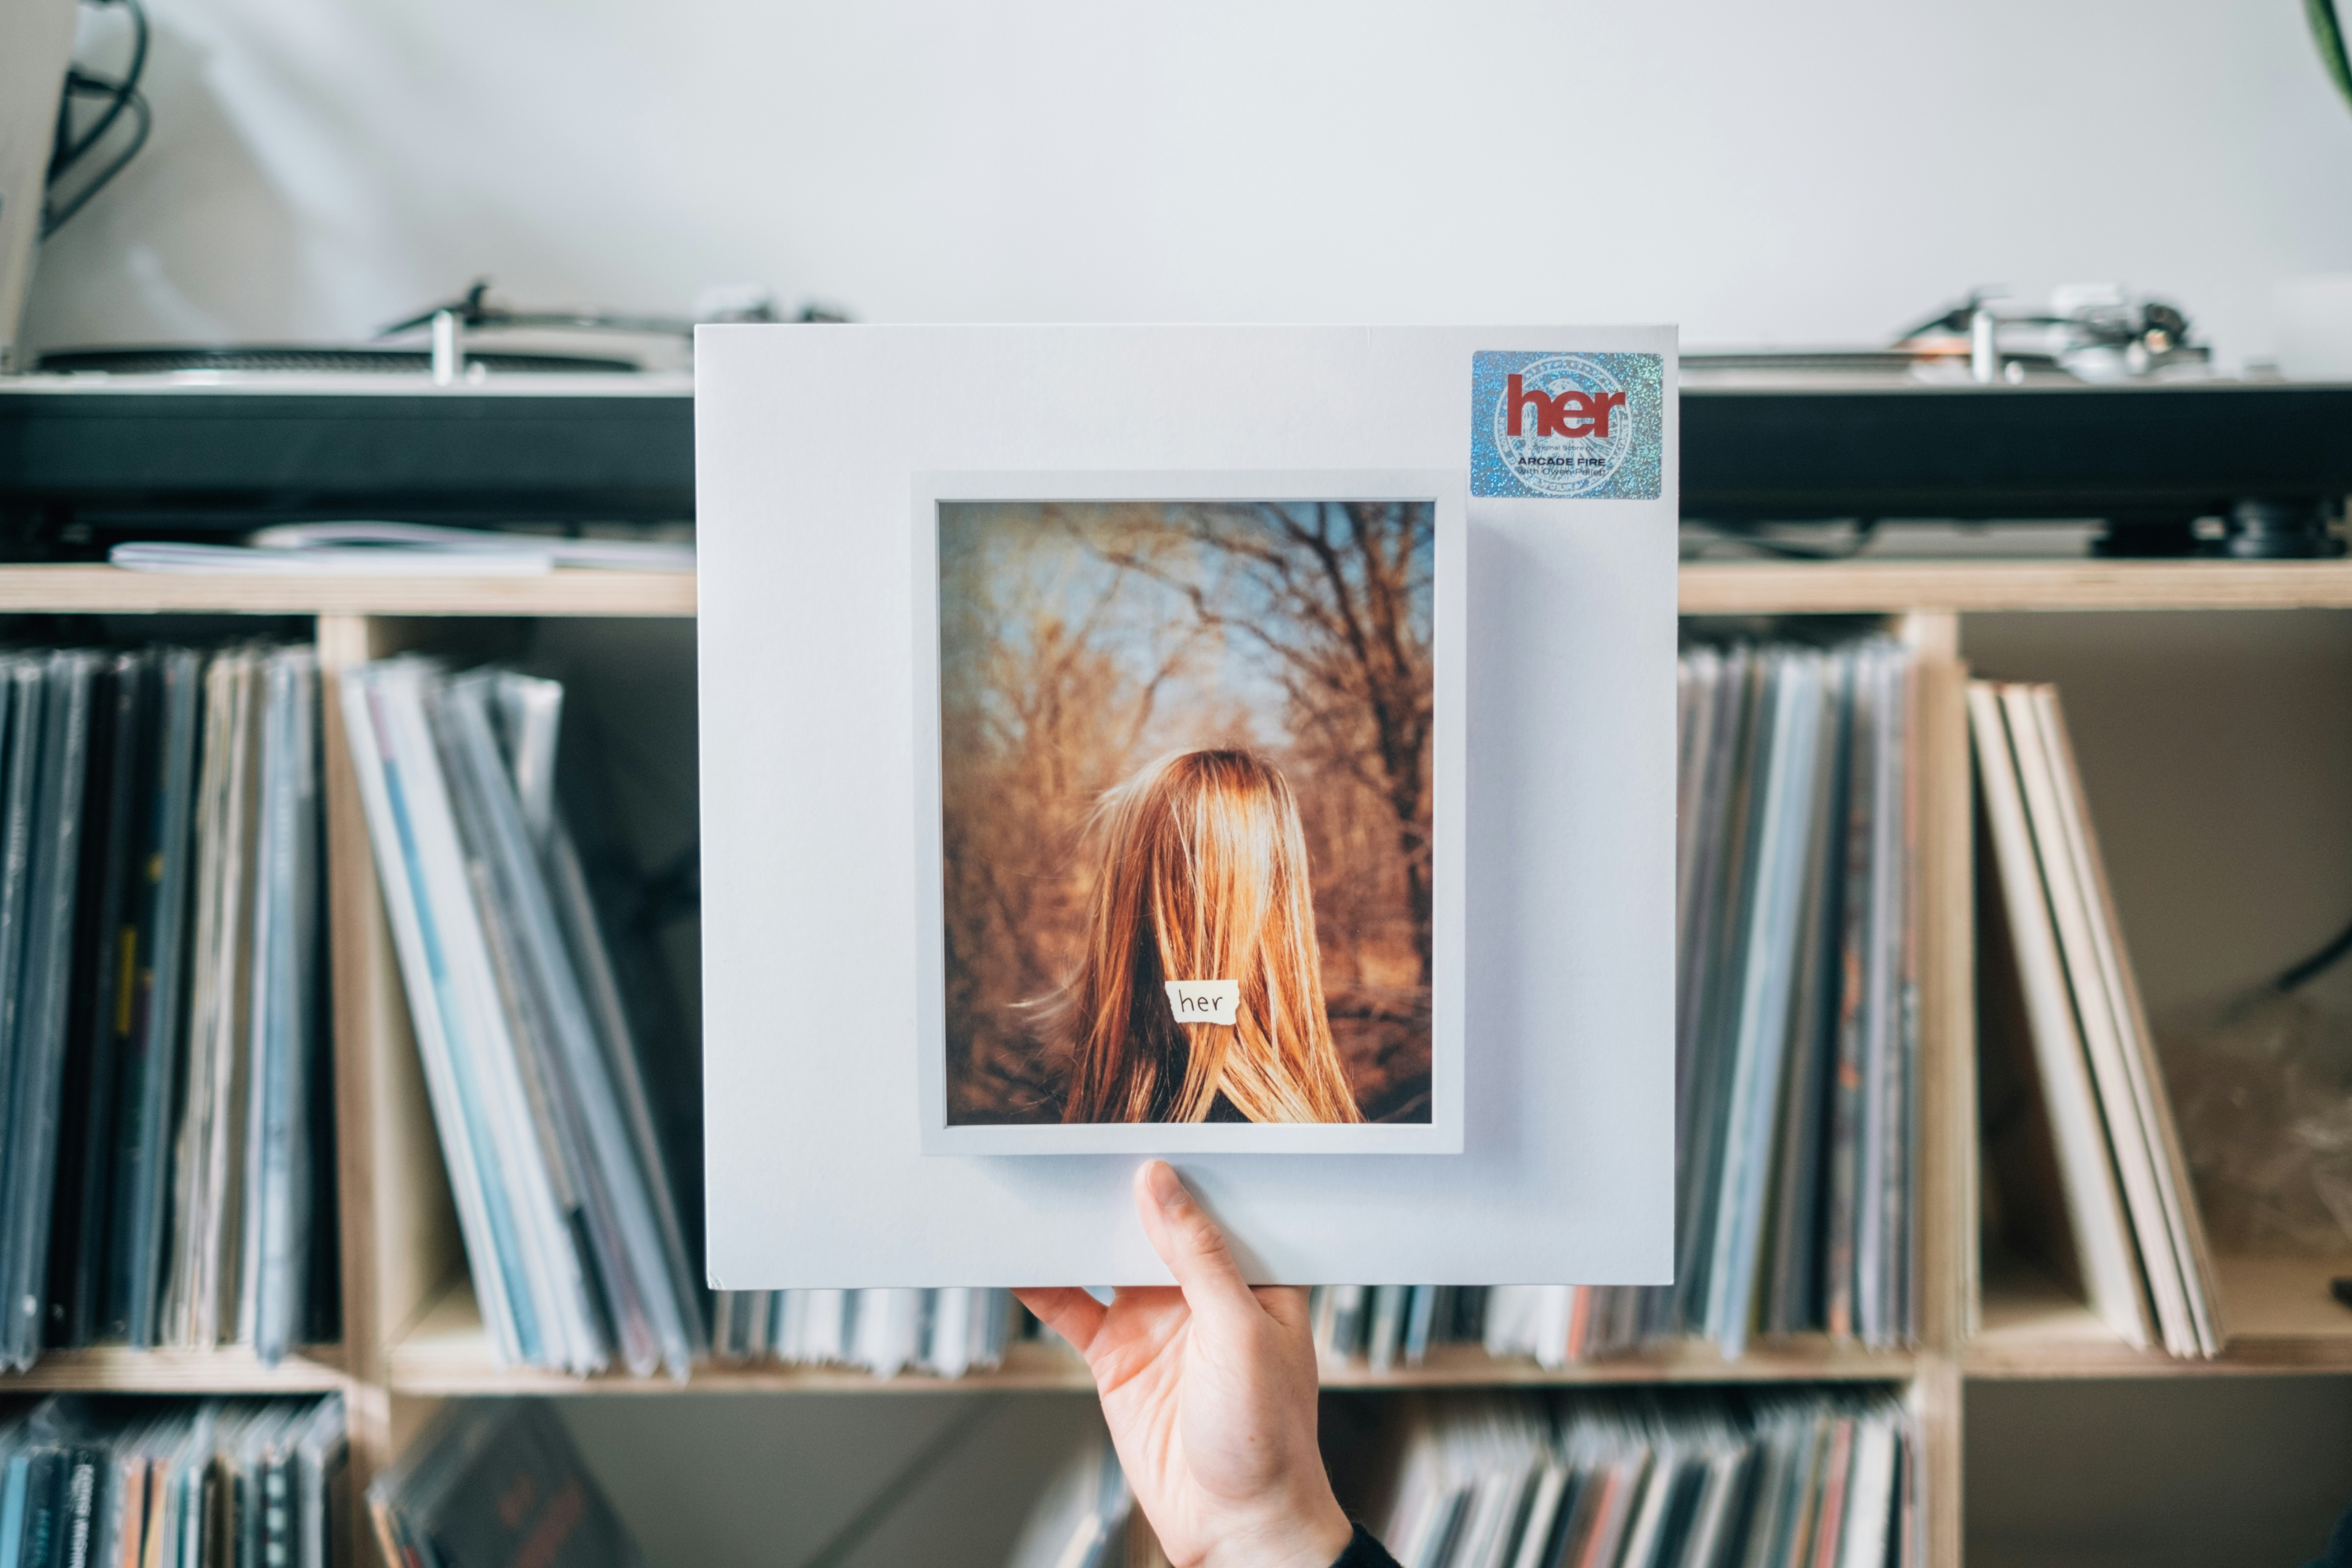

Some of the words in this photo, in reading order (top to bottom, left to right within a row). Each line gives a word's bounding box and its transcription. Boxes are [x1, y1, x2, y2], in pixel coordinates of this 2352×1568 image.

[1507, 374, 1626, 438] her
[1518, 457, 1574, 466] ARCADE
[1577, 458, 1606, 466] FIRE
[1178, 989, 1223, 1012] her
